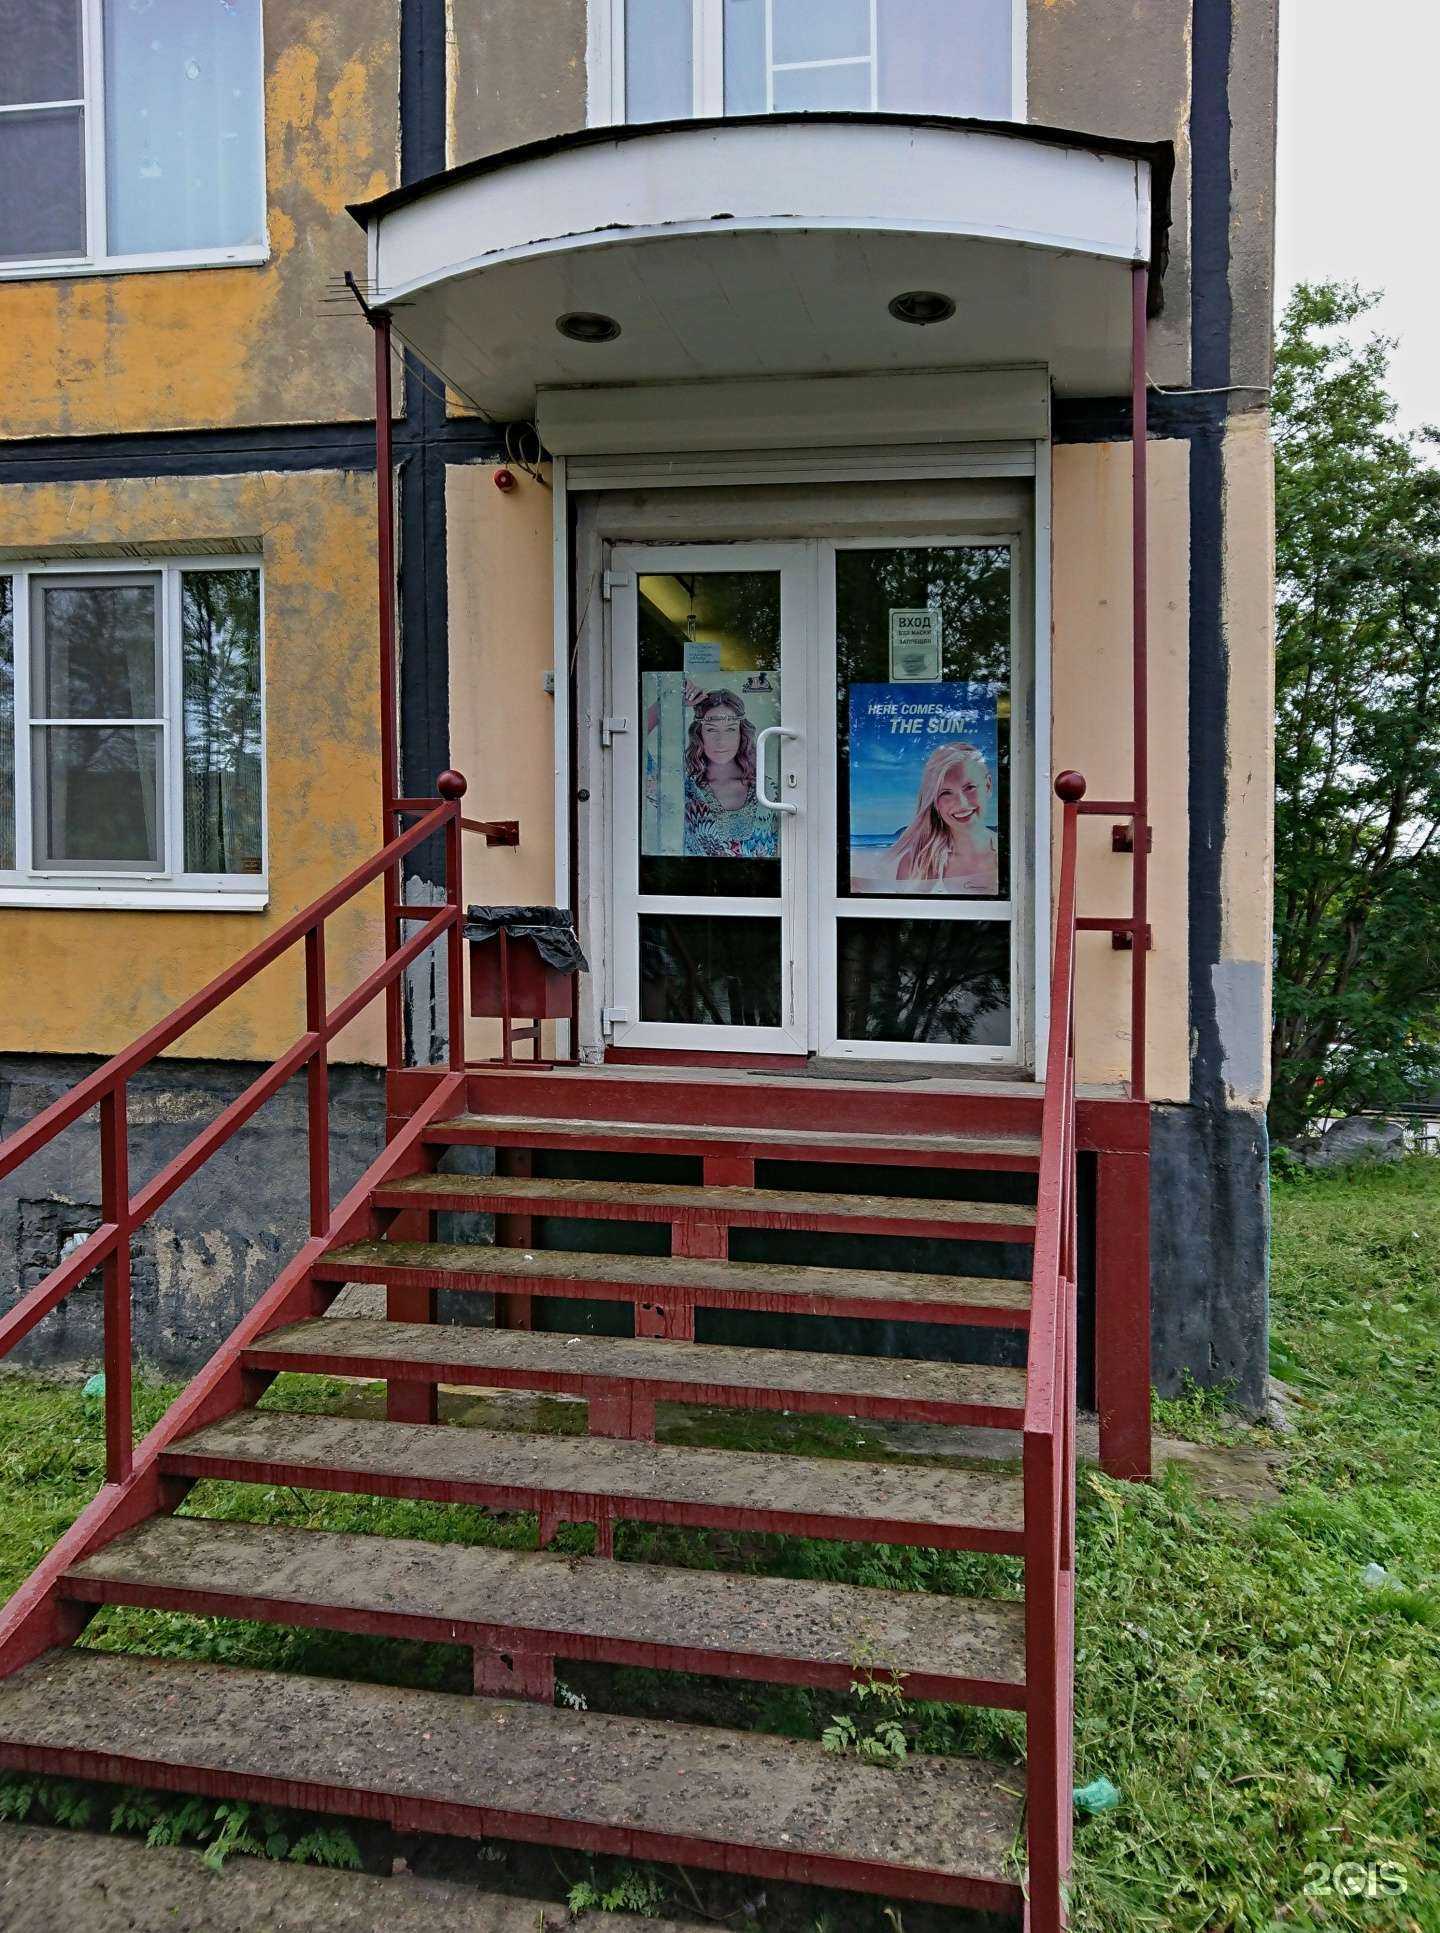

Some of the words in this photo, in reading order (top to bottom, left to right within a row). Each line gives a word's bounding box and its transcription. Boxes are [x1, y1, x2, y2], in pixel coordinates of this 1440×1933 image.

[899, 617, 931, 628] ВХОД
[868, 704, 899, 715] HERE
[890, 718, 924, 734] THE
